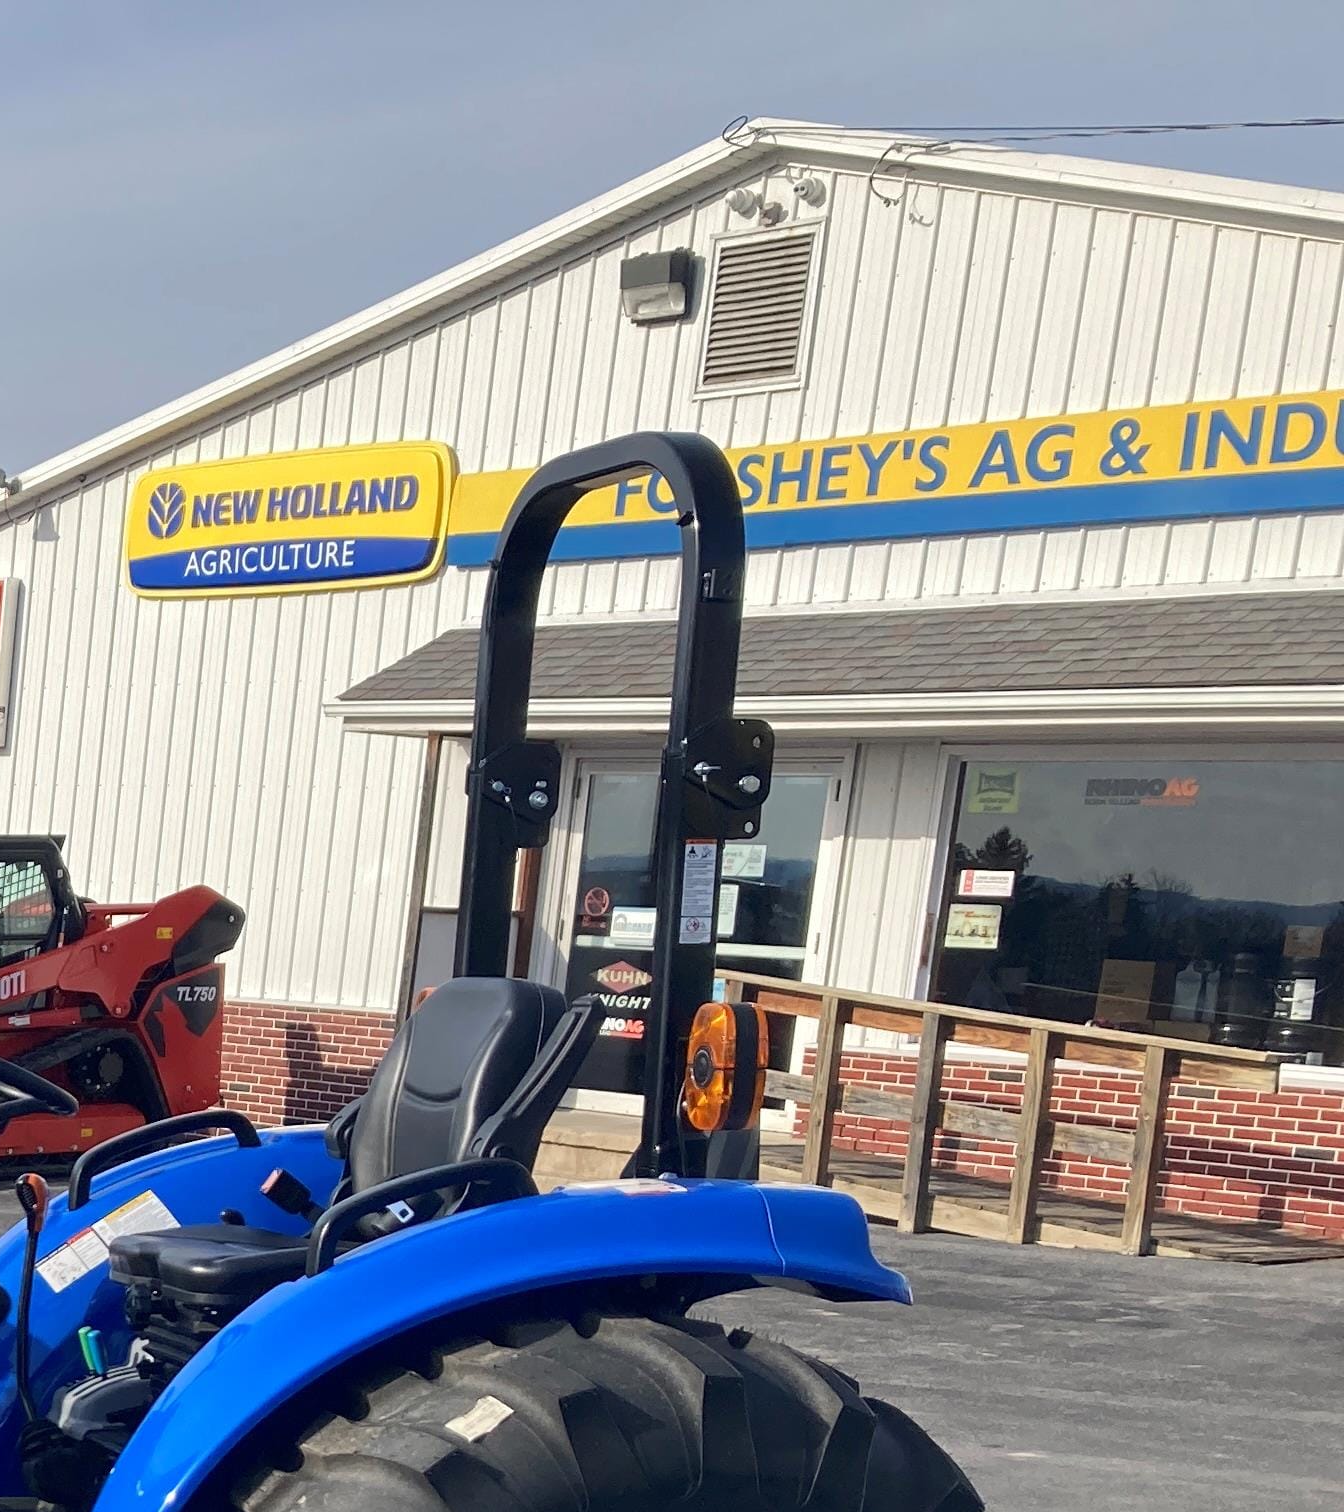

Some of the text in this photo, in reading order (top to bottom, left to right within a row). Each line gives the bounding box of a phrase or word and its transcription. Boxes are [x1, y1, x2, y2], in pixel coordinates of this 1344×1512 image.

[615, 399, 1344, 517] FOSHEY'S AG & IND
[191, 474, 419, 528] NEW HOLLAND
[184, 540, 355, 577] AGRICULTURE
[597, 969, 648, 986] KUHN
[176, 986, 217, 1001] TL750
[598, 993, 652, 1010] NIGHT
